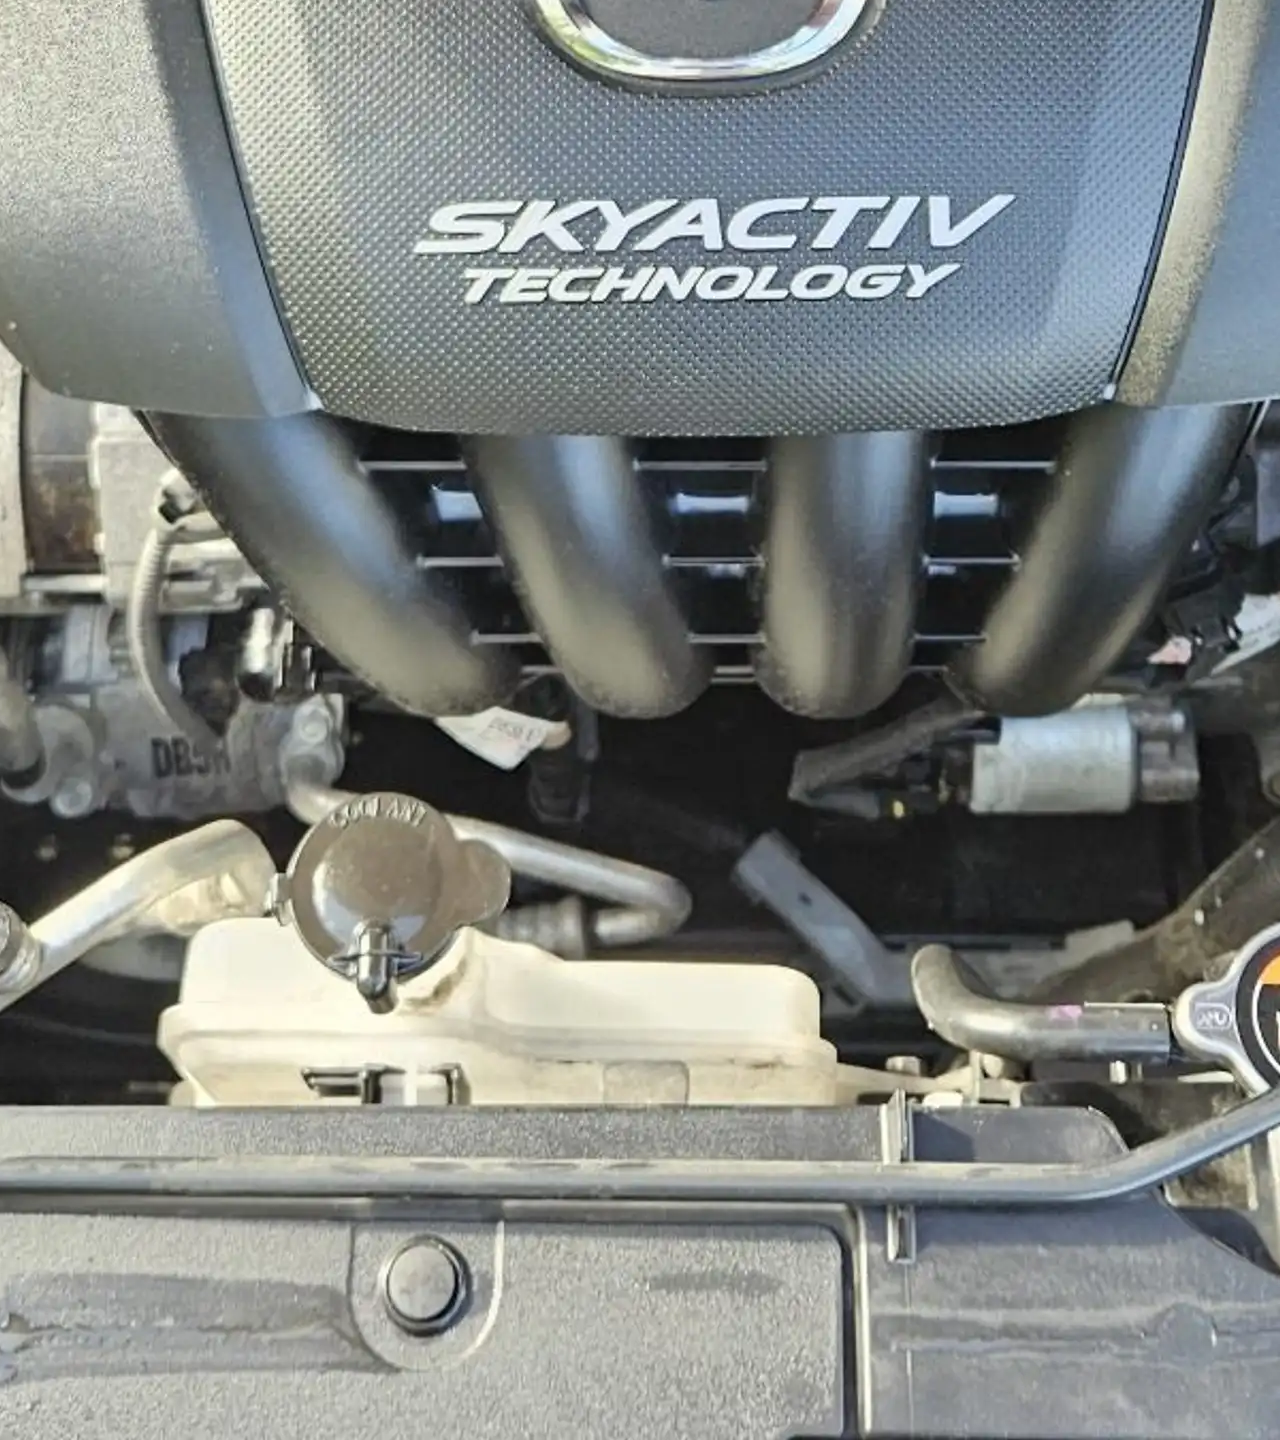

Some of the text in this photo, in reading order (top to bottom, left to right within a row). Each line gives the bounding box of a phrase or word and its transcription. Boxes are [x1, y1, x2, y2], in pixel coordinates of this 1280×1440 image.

[413, 194, 1017, 254] SKYACTIV
[463, 263, 962, 303] TECHNOLOGY
[327, 796, 428, 829] COOLANT
